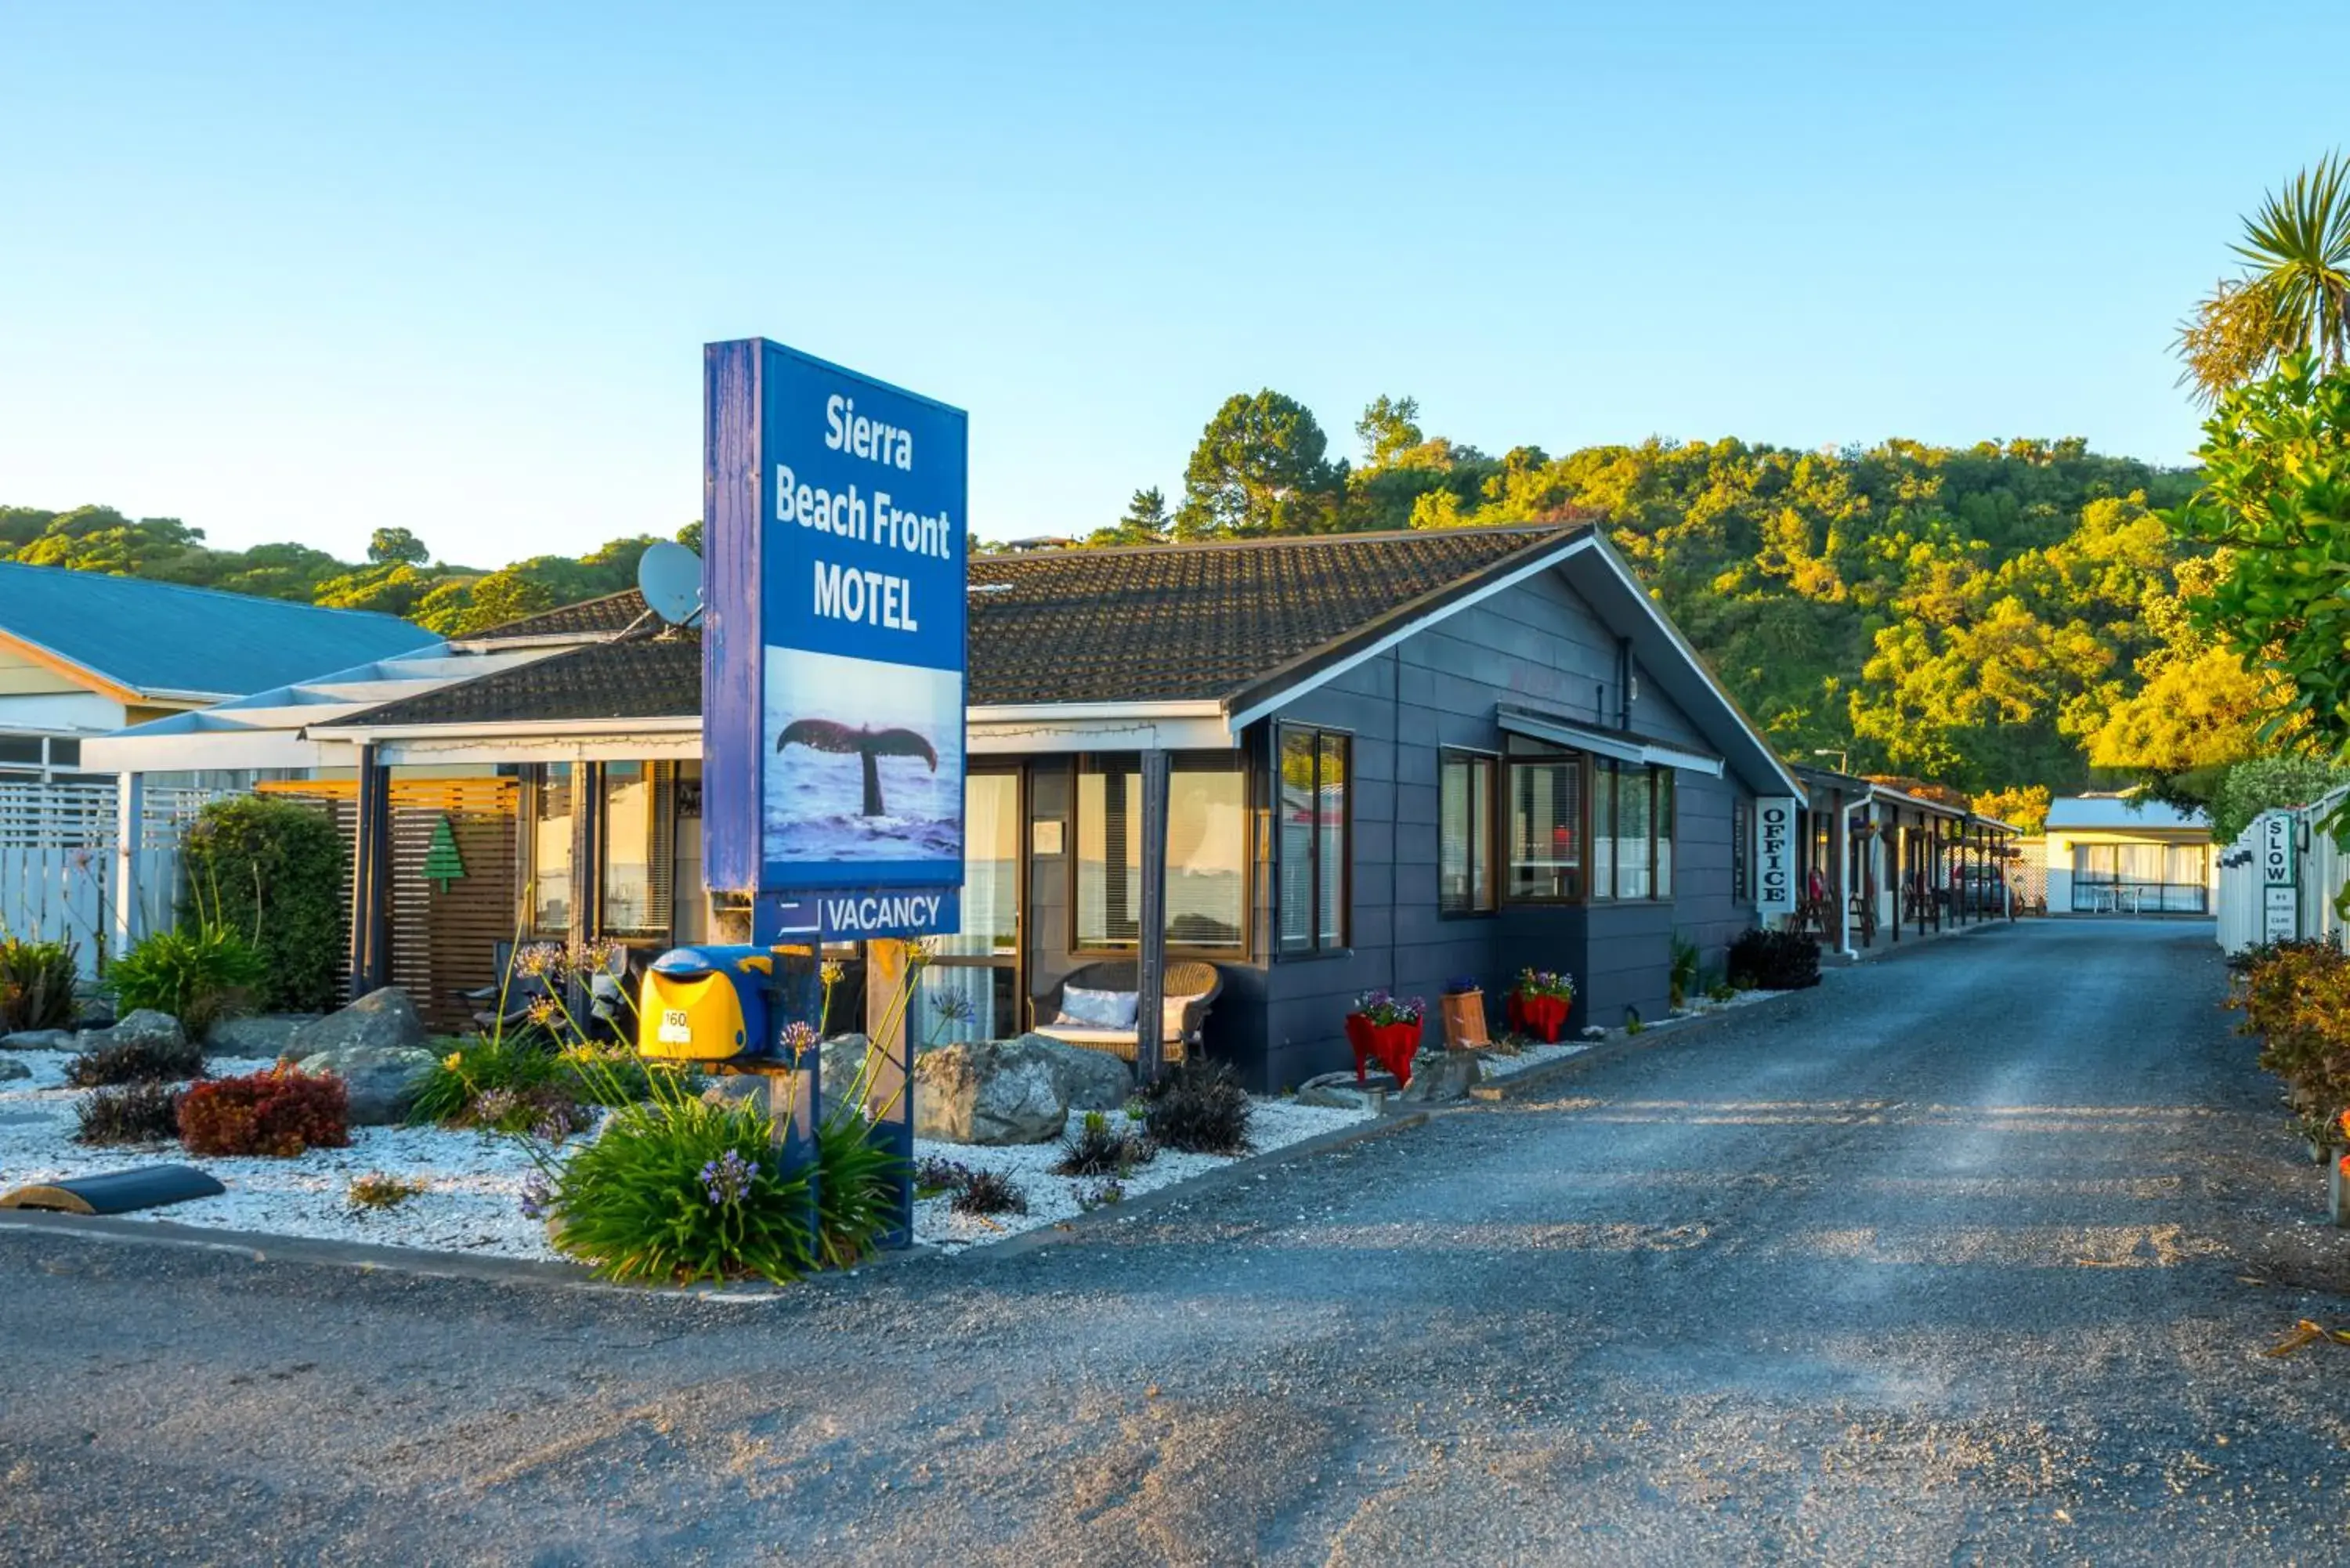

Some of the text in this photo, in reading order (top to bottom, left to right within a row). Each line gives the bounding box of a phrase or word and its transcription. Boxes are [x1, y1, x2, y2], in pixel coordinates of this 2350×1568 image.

[825, 394, 913, 471] Sierra
[776, 464, 950, 560] Beach Front
[814, 559, 917, 632] MOTEL
[1763, 808, 1785, 902] OFFICE
[2267, 822, 2286, 880] SLOW
[828, 895, 941, 931] VACANCY
[666, 1012, 687, 1027] 160
